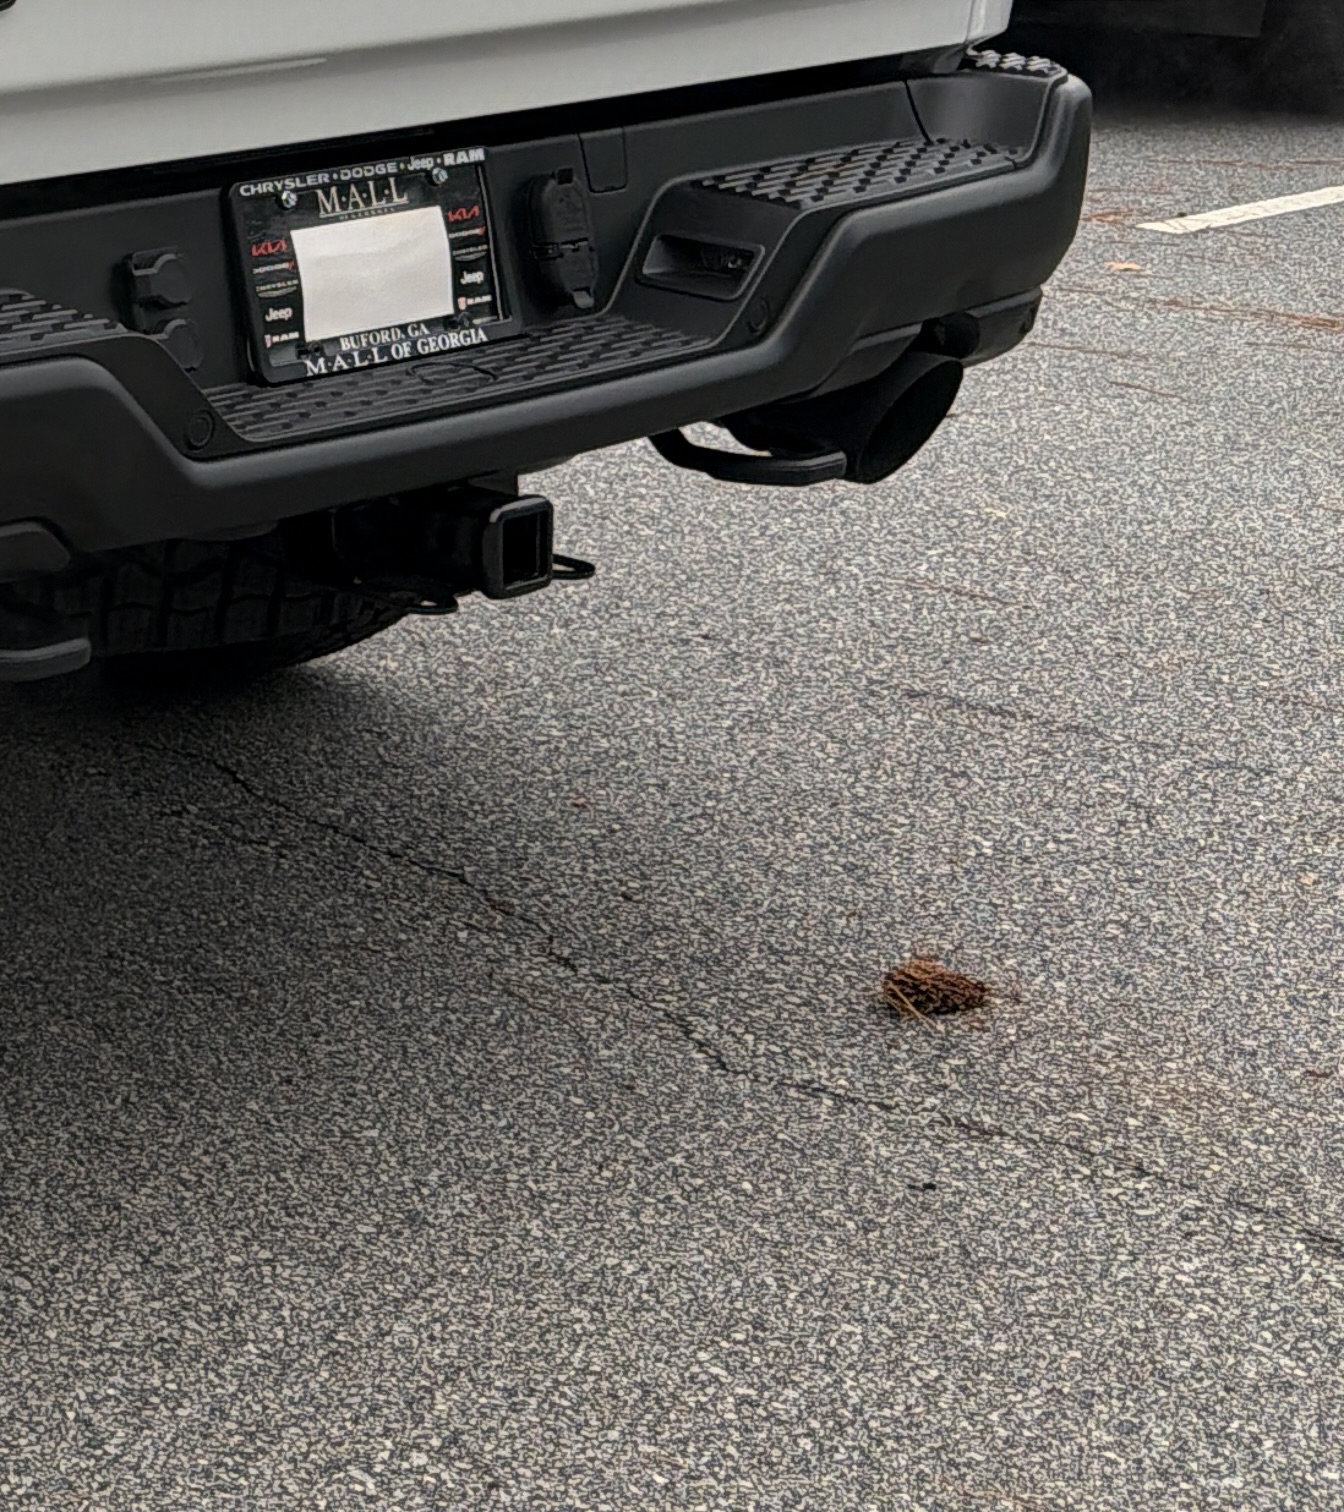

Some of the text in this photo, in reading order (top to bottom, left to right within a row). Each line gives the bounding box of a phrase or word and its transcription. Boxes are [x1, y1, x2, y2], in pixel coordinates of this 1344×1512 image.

[239, 148, 486, 197] CHRYSLER DODGE Jeep RAM
[460, 270, 484, 285] Jeep
[265, 307, 292, 322] Jeep
[407, 322, 430, 337] GA
[391, 341, 413, 361] OF
[416, 327, 489, 355] GEORGIA
